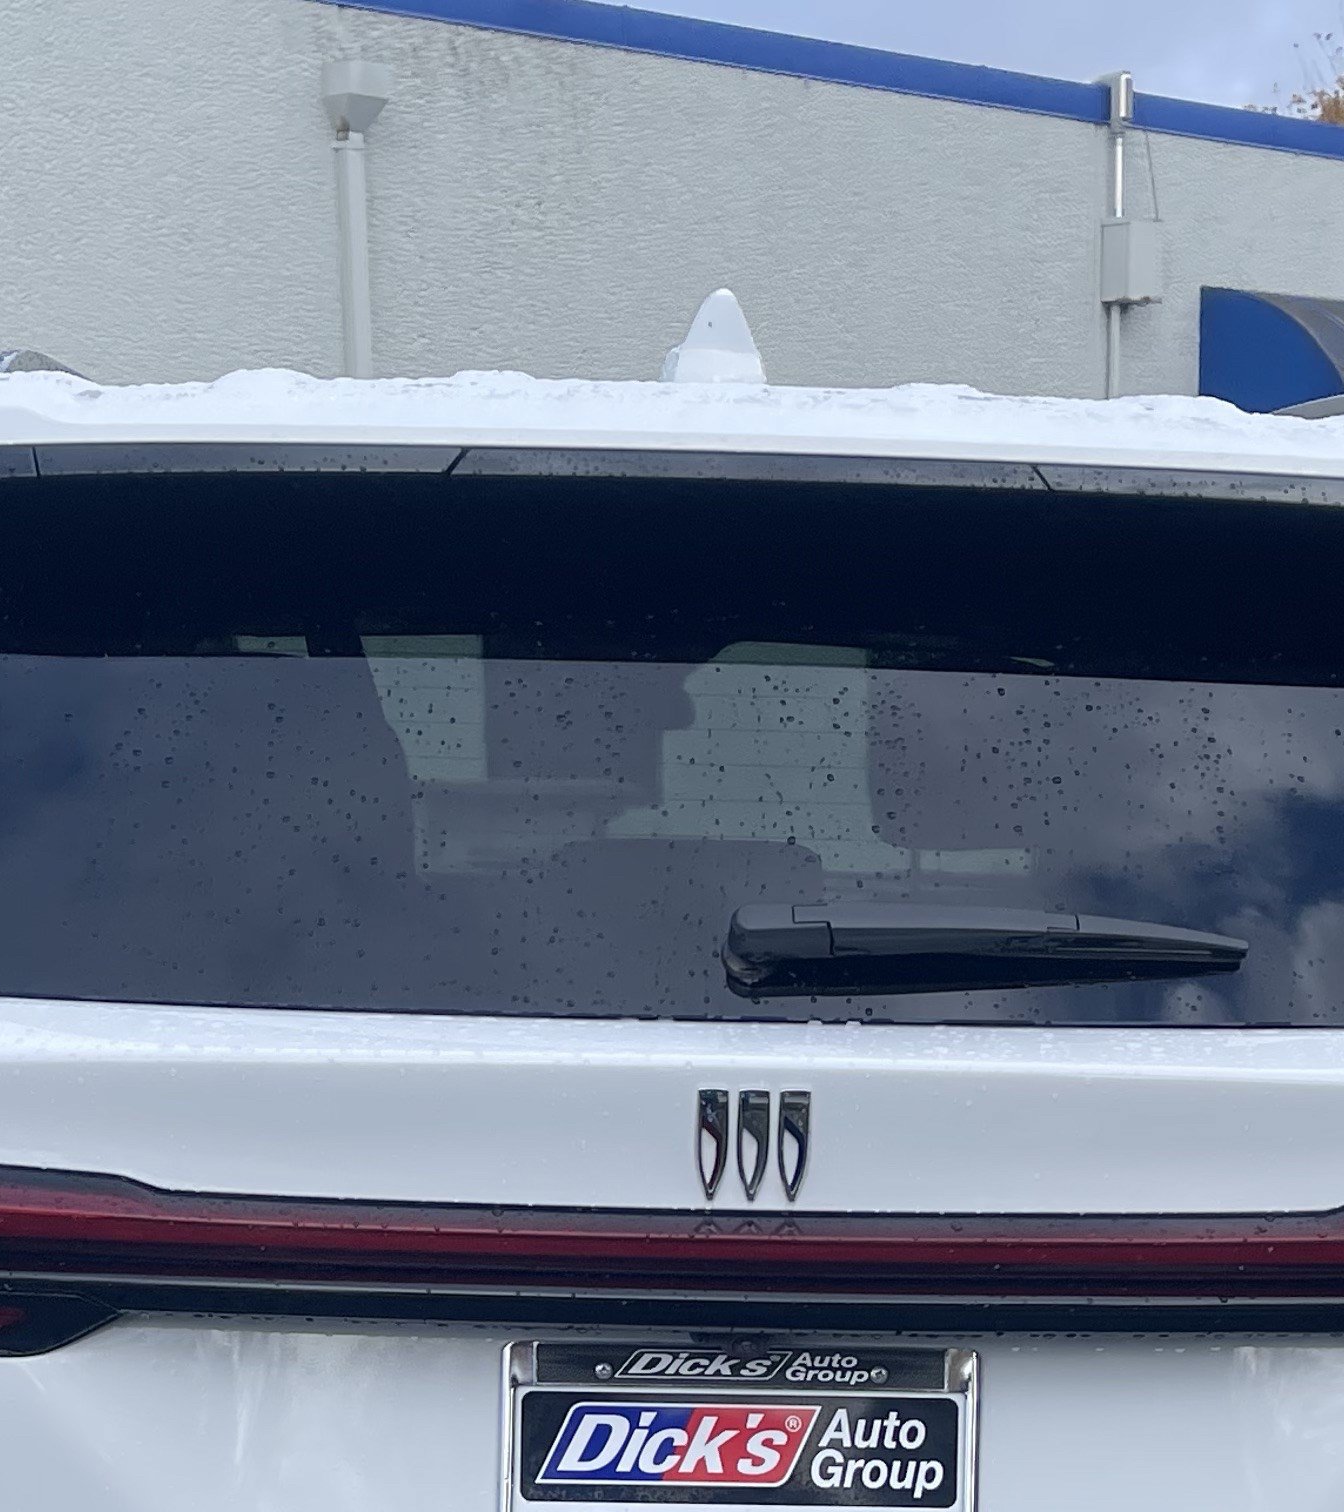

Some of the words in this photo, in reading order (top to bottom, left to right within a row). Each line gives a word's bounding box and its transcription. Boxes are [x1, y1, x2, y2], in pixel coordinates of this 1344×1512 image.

[627, 1352, 773, 1377] Dicks
[785, 1366, 869, 1385] Group
[792, 1352, 858, 1369] Auto
[556, 1412, 786, 1475] Dick's
[817, 1407, 926, 1450] Auto
[810, 1448, 944, 1497] Group
